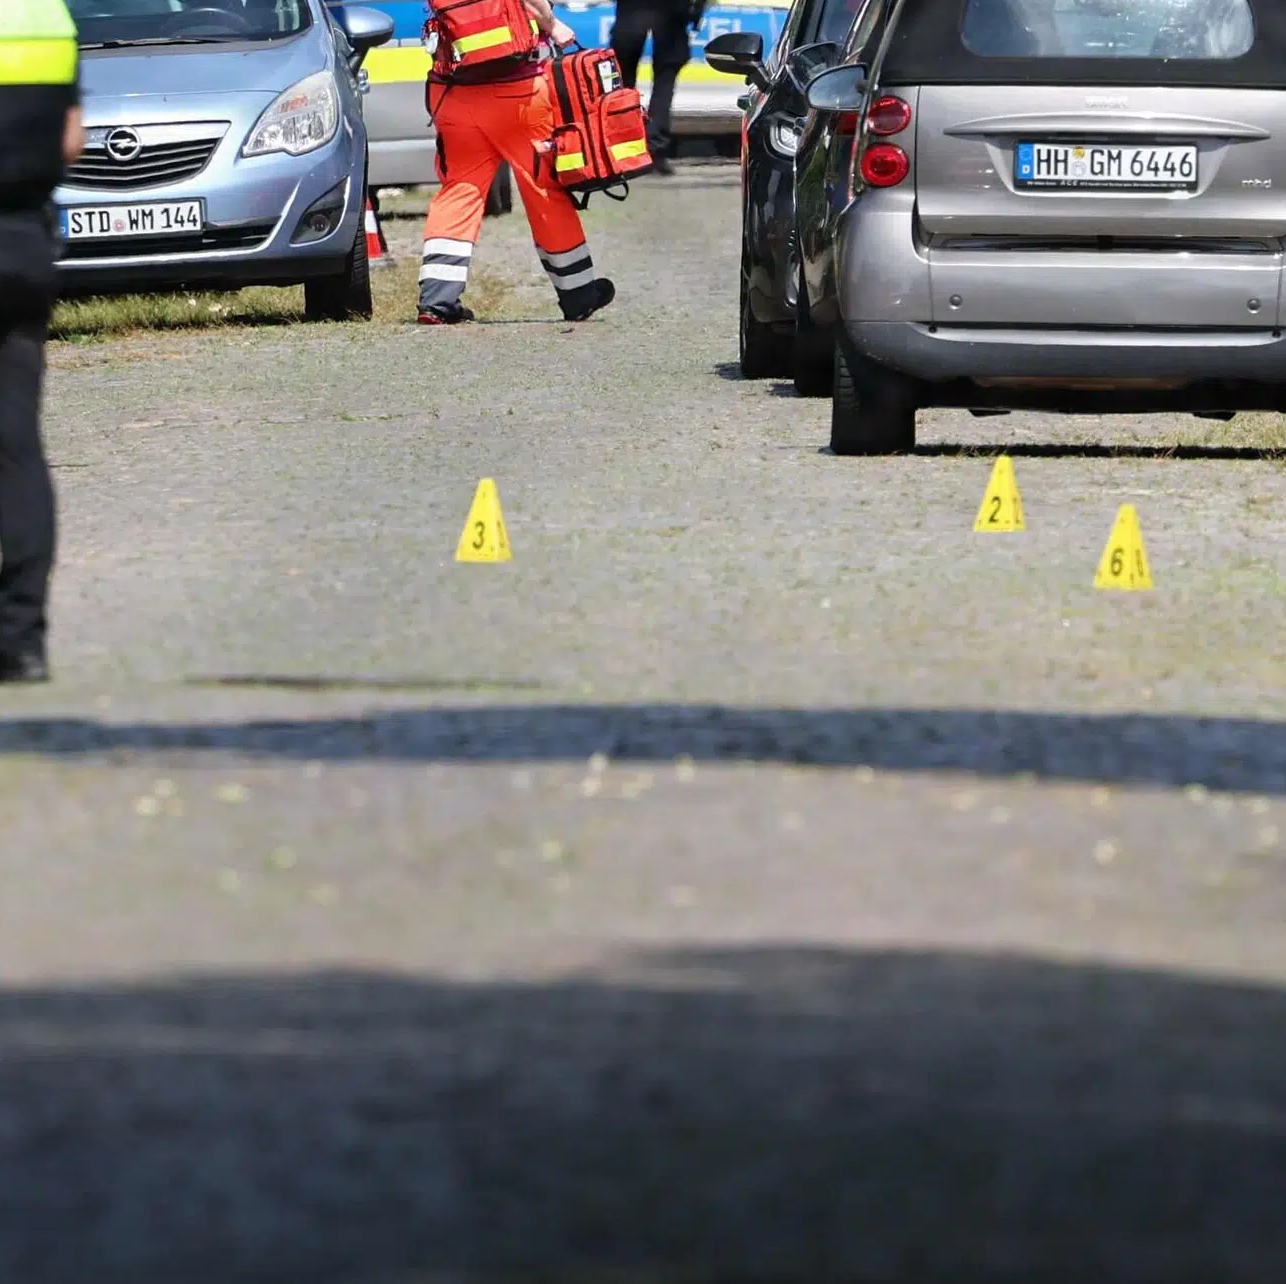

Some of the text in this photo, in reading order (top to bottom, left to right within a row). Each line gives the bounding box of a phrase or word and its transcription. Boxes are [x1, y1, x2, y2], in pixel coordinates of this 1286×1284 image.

[1036, 148, 1069, 176] HH
[1089, 149, 1122, 177] GM
[1130, 150, 1193, 178] 6446
[71, 205, 198, 234] STD WM 144
[988, 495, 1002, 524] 2
[472, 520, 486, 550] 3
[1110, 547, 1124, 577] 6
